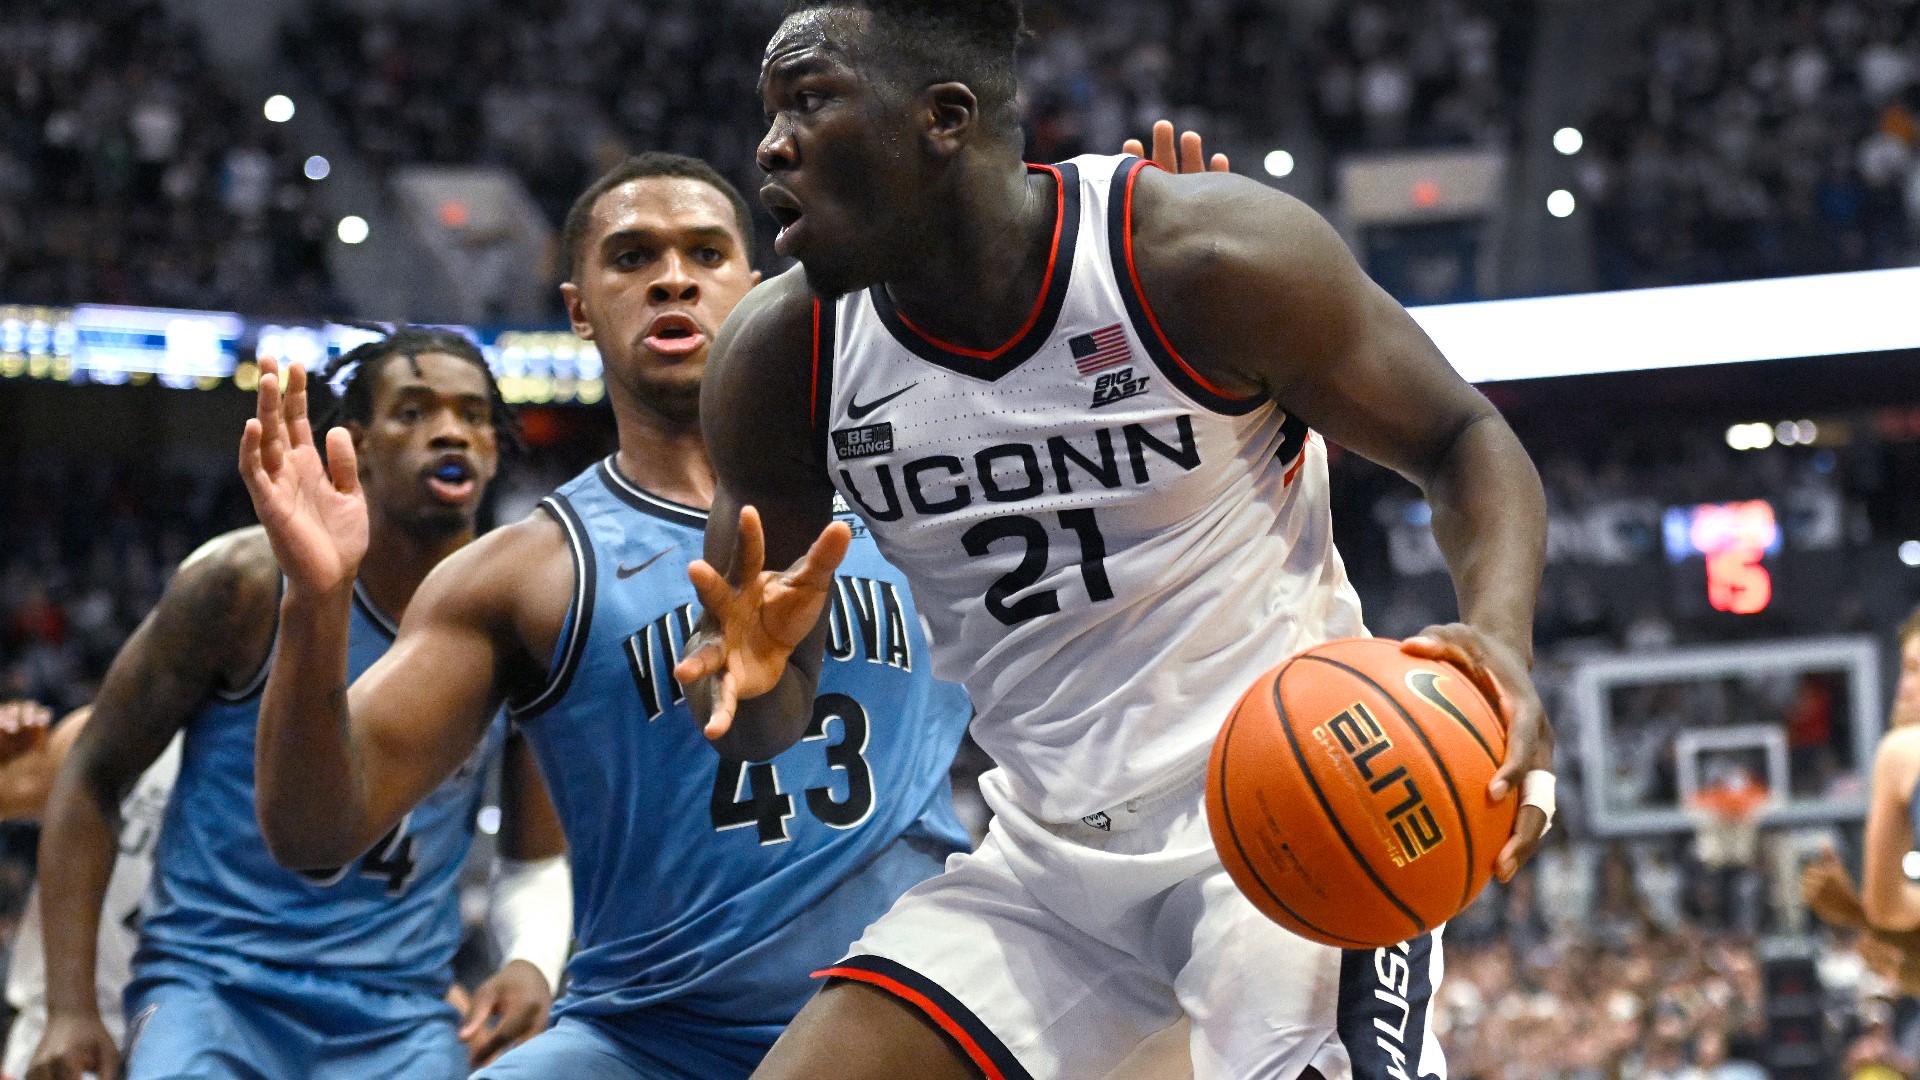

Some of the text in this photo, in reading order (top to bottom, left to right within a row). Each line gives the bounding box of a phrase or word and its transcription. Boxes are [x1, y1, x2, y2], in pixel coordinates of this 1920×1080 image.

[1092, 376, 1150, 404] EAST
[1095, 368, 1133, 391] BIG
[838, 439, 891, 457] CHANGE
[840, 414, 1201, 522] UCONN
[847, 429, 873, 445] BE
[961, 507, 1114, 625] 21
[710, 692, 876, 846] 43
[1325, 701, 1446, 863] ELITE
